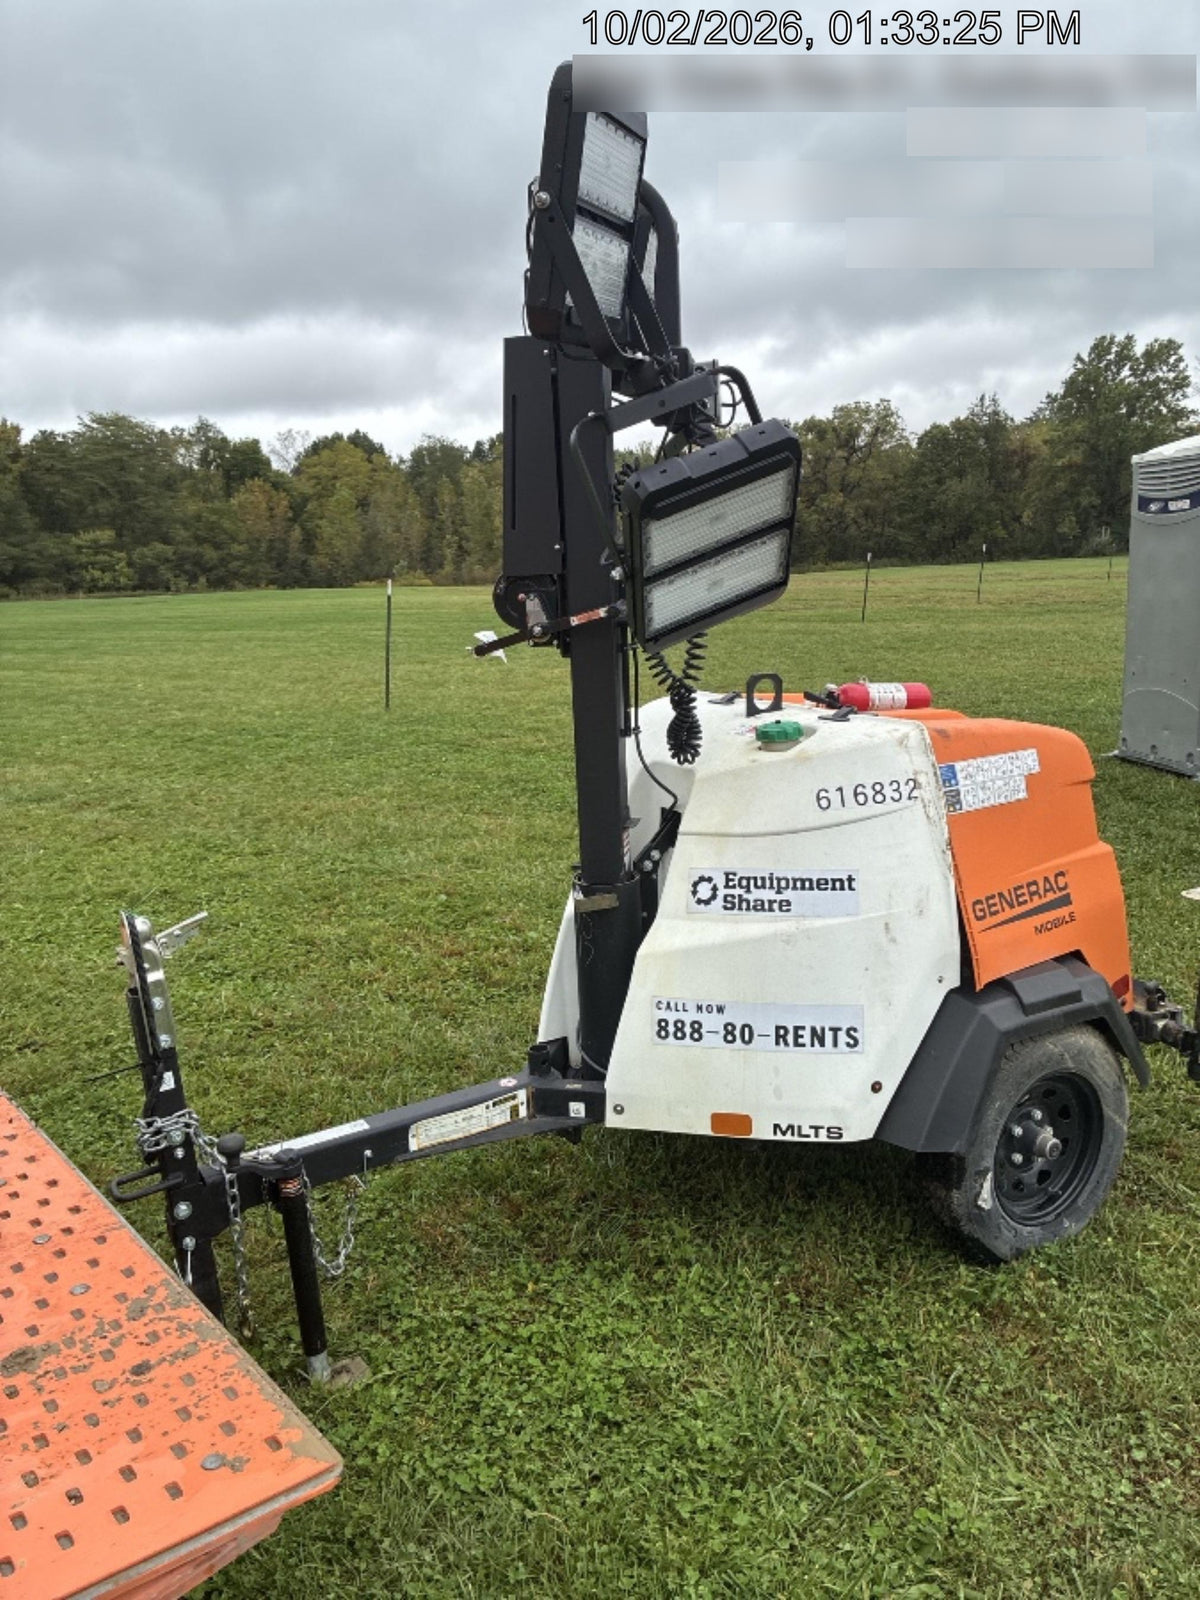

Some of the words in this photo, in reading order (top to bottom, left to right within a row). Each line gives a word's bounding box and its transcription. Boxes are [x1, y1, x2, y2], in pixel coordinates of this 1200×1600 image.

[815, 777, 919, 812] 616832
[723, 871, 856, 895] Equipment
[722, 893, 792, 913] Share
[971, 870, 1069, 922] GENERAC
[1034, 911, 1077, 936] MOBILE
[655, 1000, 689, 1013] CALL
[696, 1003, 726, 1015] NOW
[655, 1017, 860, 1049] 888-80-RENTS
[772, 1123, 844, 1139] MLTS
